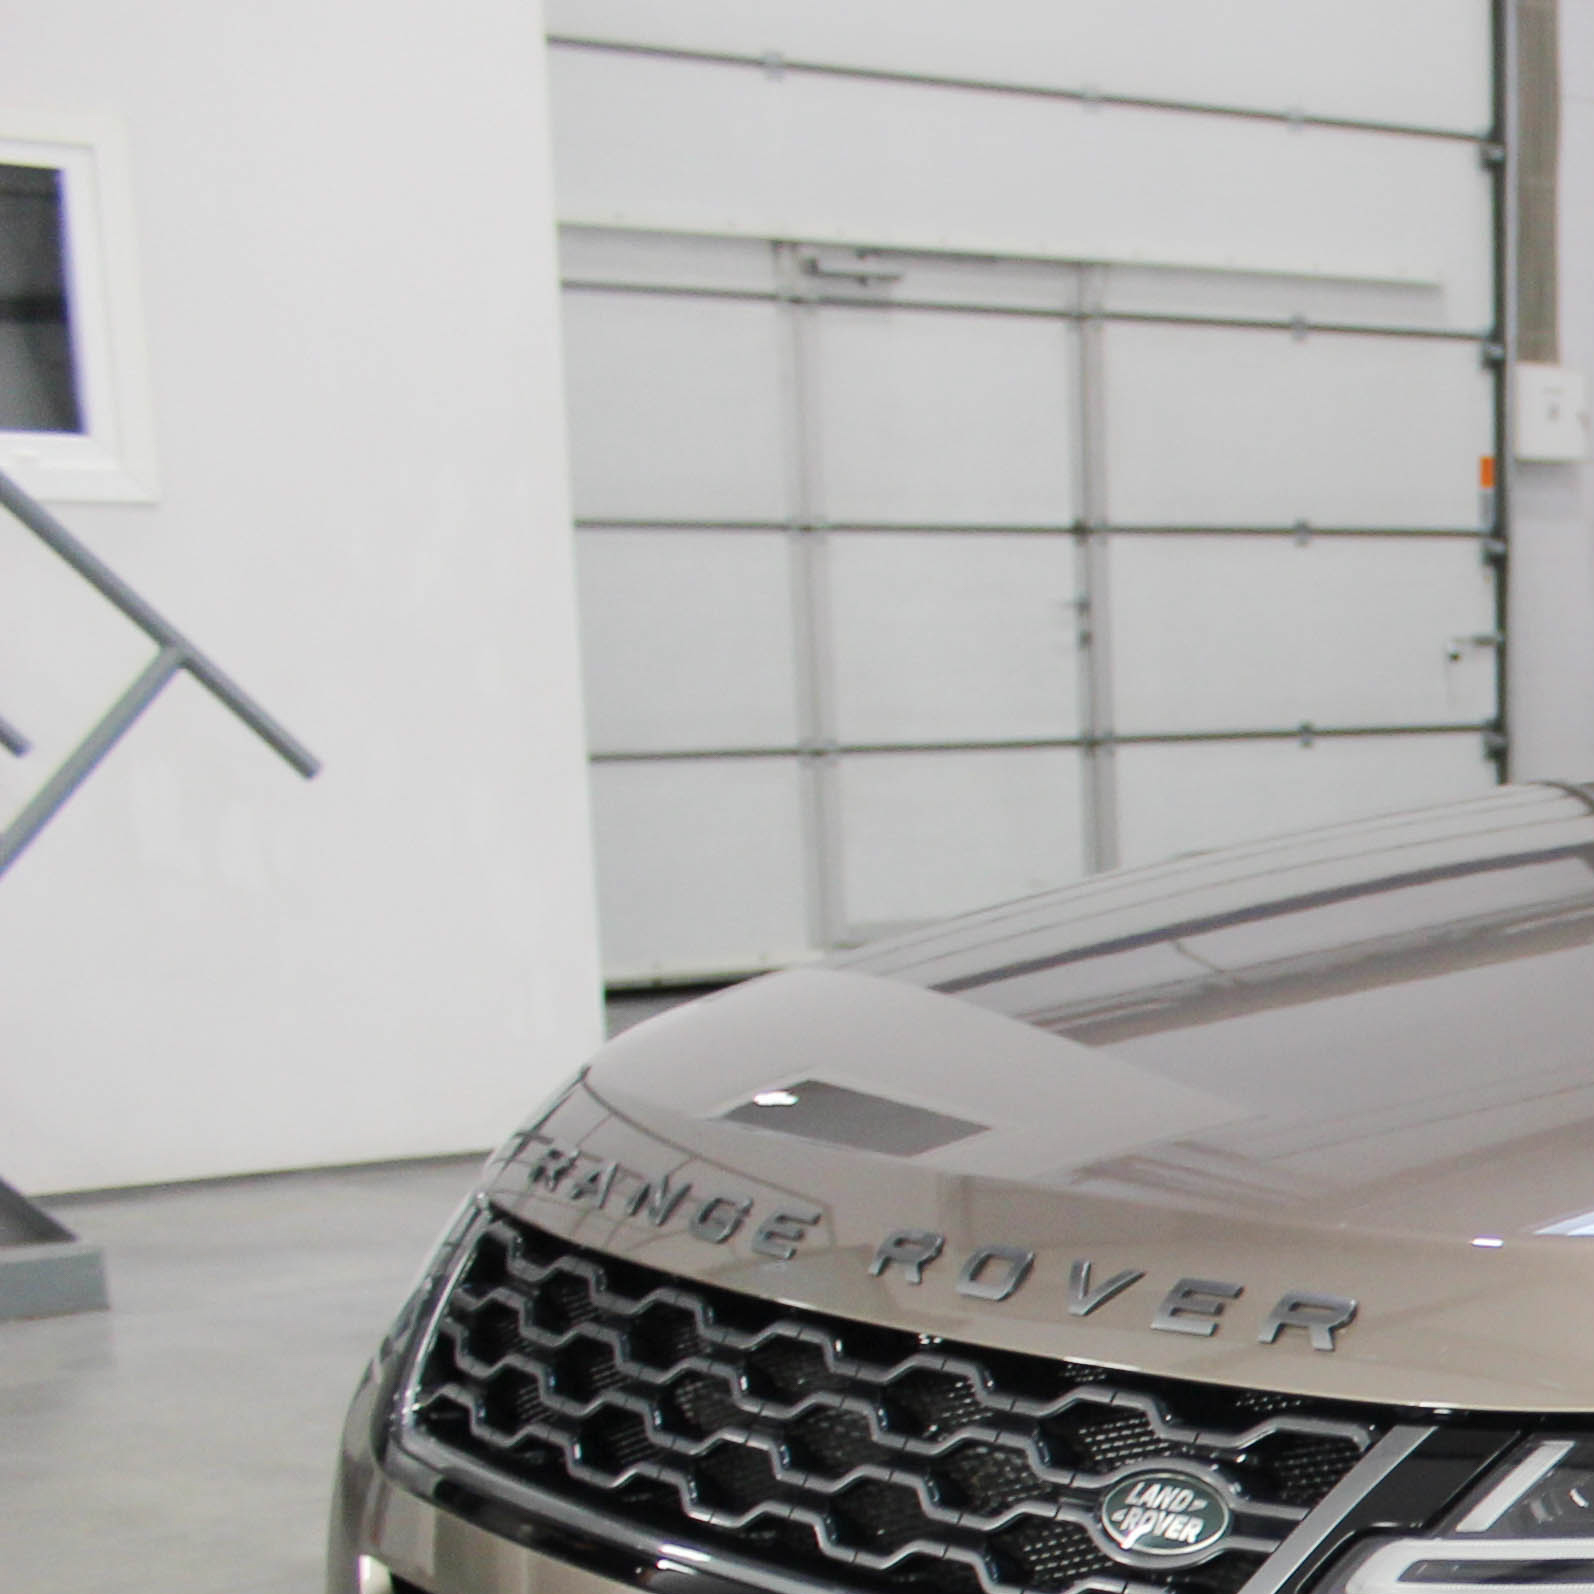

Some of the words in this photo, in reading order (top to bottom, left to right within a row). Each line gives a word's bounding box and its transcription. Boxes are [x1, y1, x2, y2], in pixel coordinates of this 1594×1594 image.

[527, 1147, 823, 1261] RANGE
[867, 1228, 1360, 1352] ROVER
[1124, 1481, 1194, 1513] LAND
[1119, 1506, 1204, 1544] ROVER
